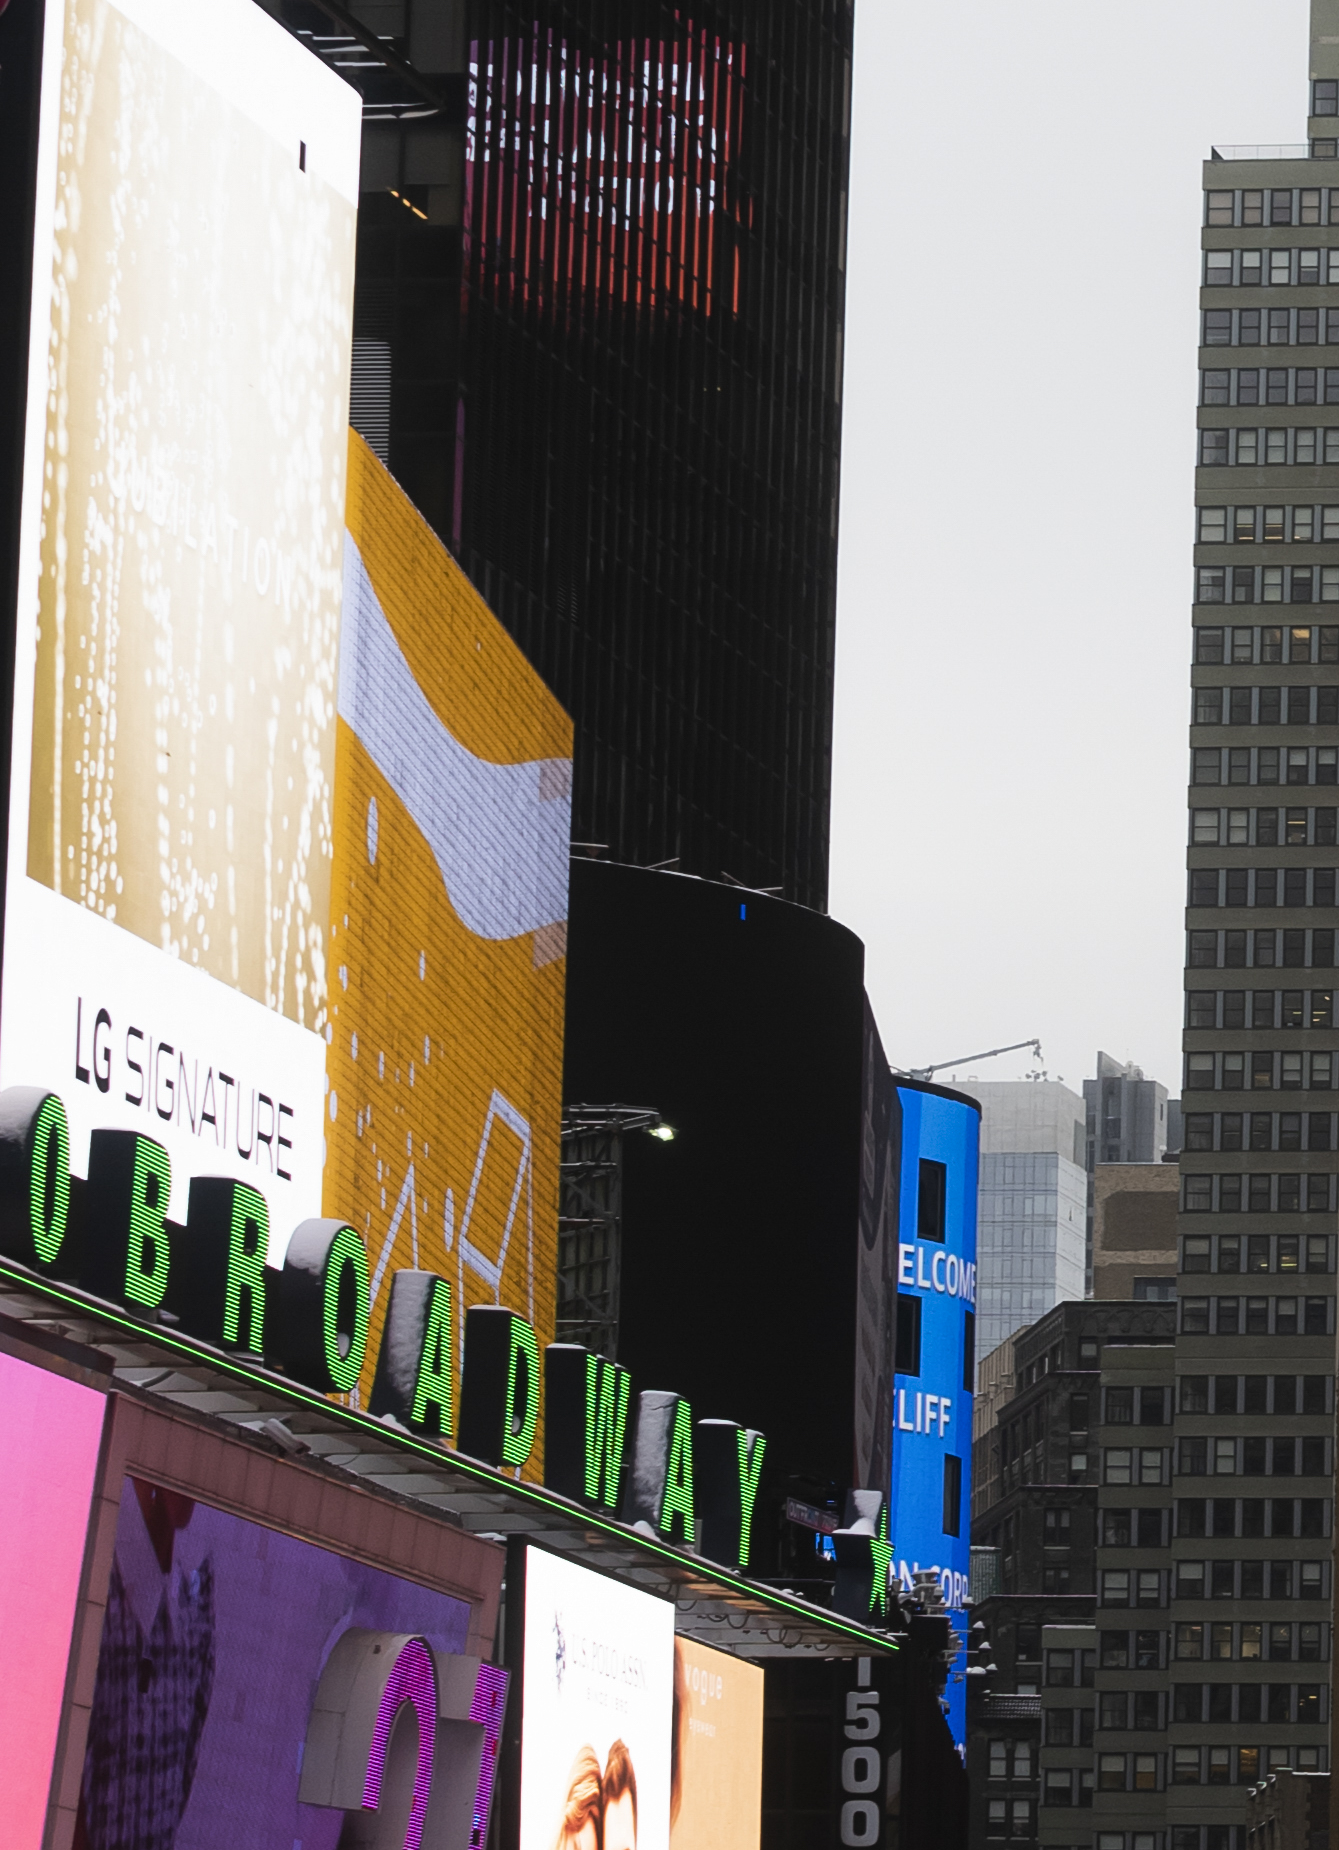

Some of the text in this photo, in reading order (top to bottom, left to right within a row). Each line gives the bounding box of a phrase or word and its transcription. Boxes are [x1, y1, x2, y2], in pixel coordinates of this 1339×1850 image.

[75, 996, 294, 1182] LG SIGNATURE
[125, 1136, 767, 1567] BROADWAY
[685, 1662, 723, 1706] vogue
